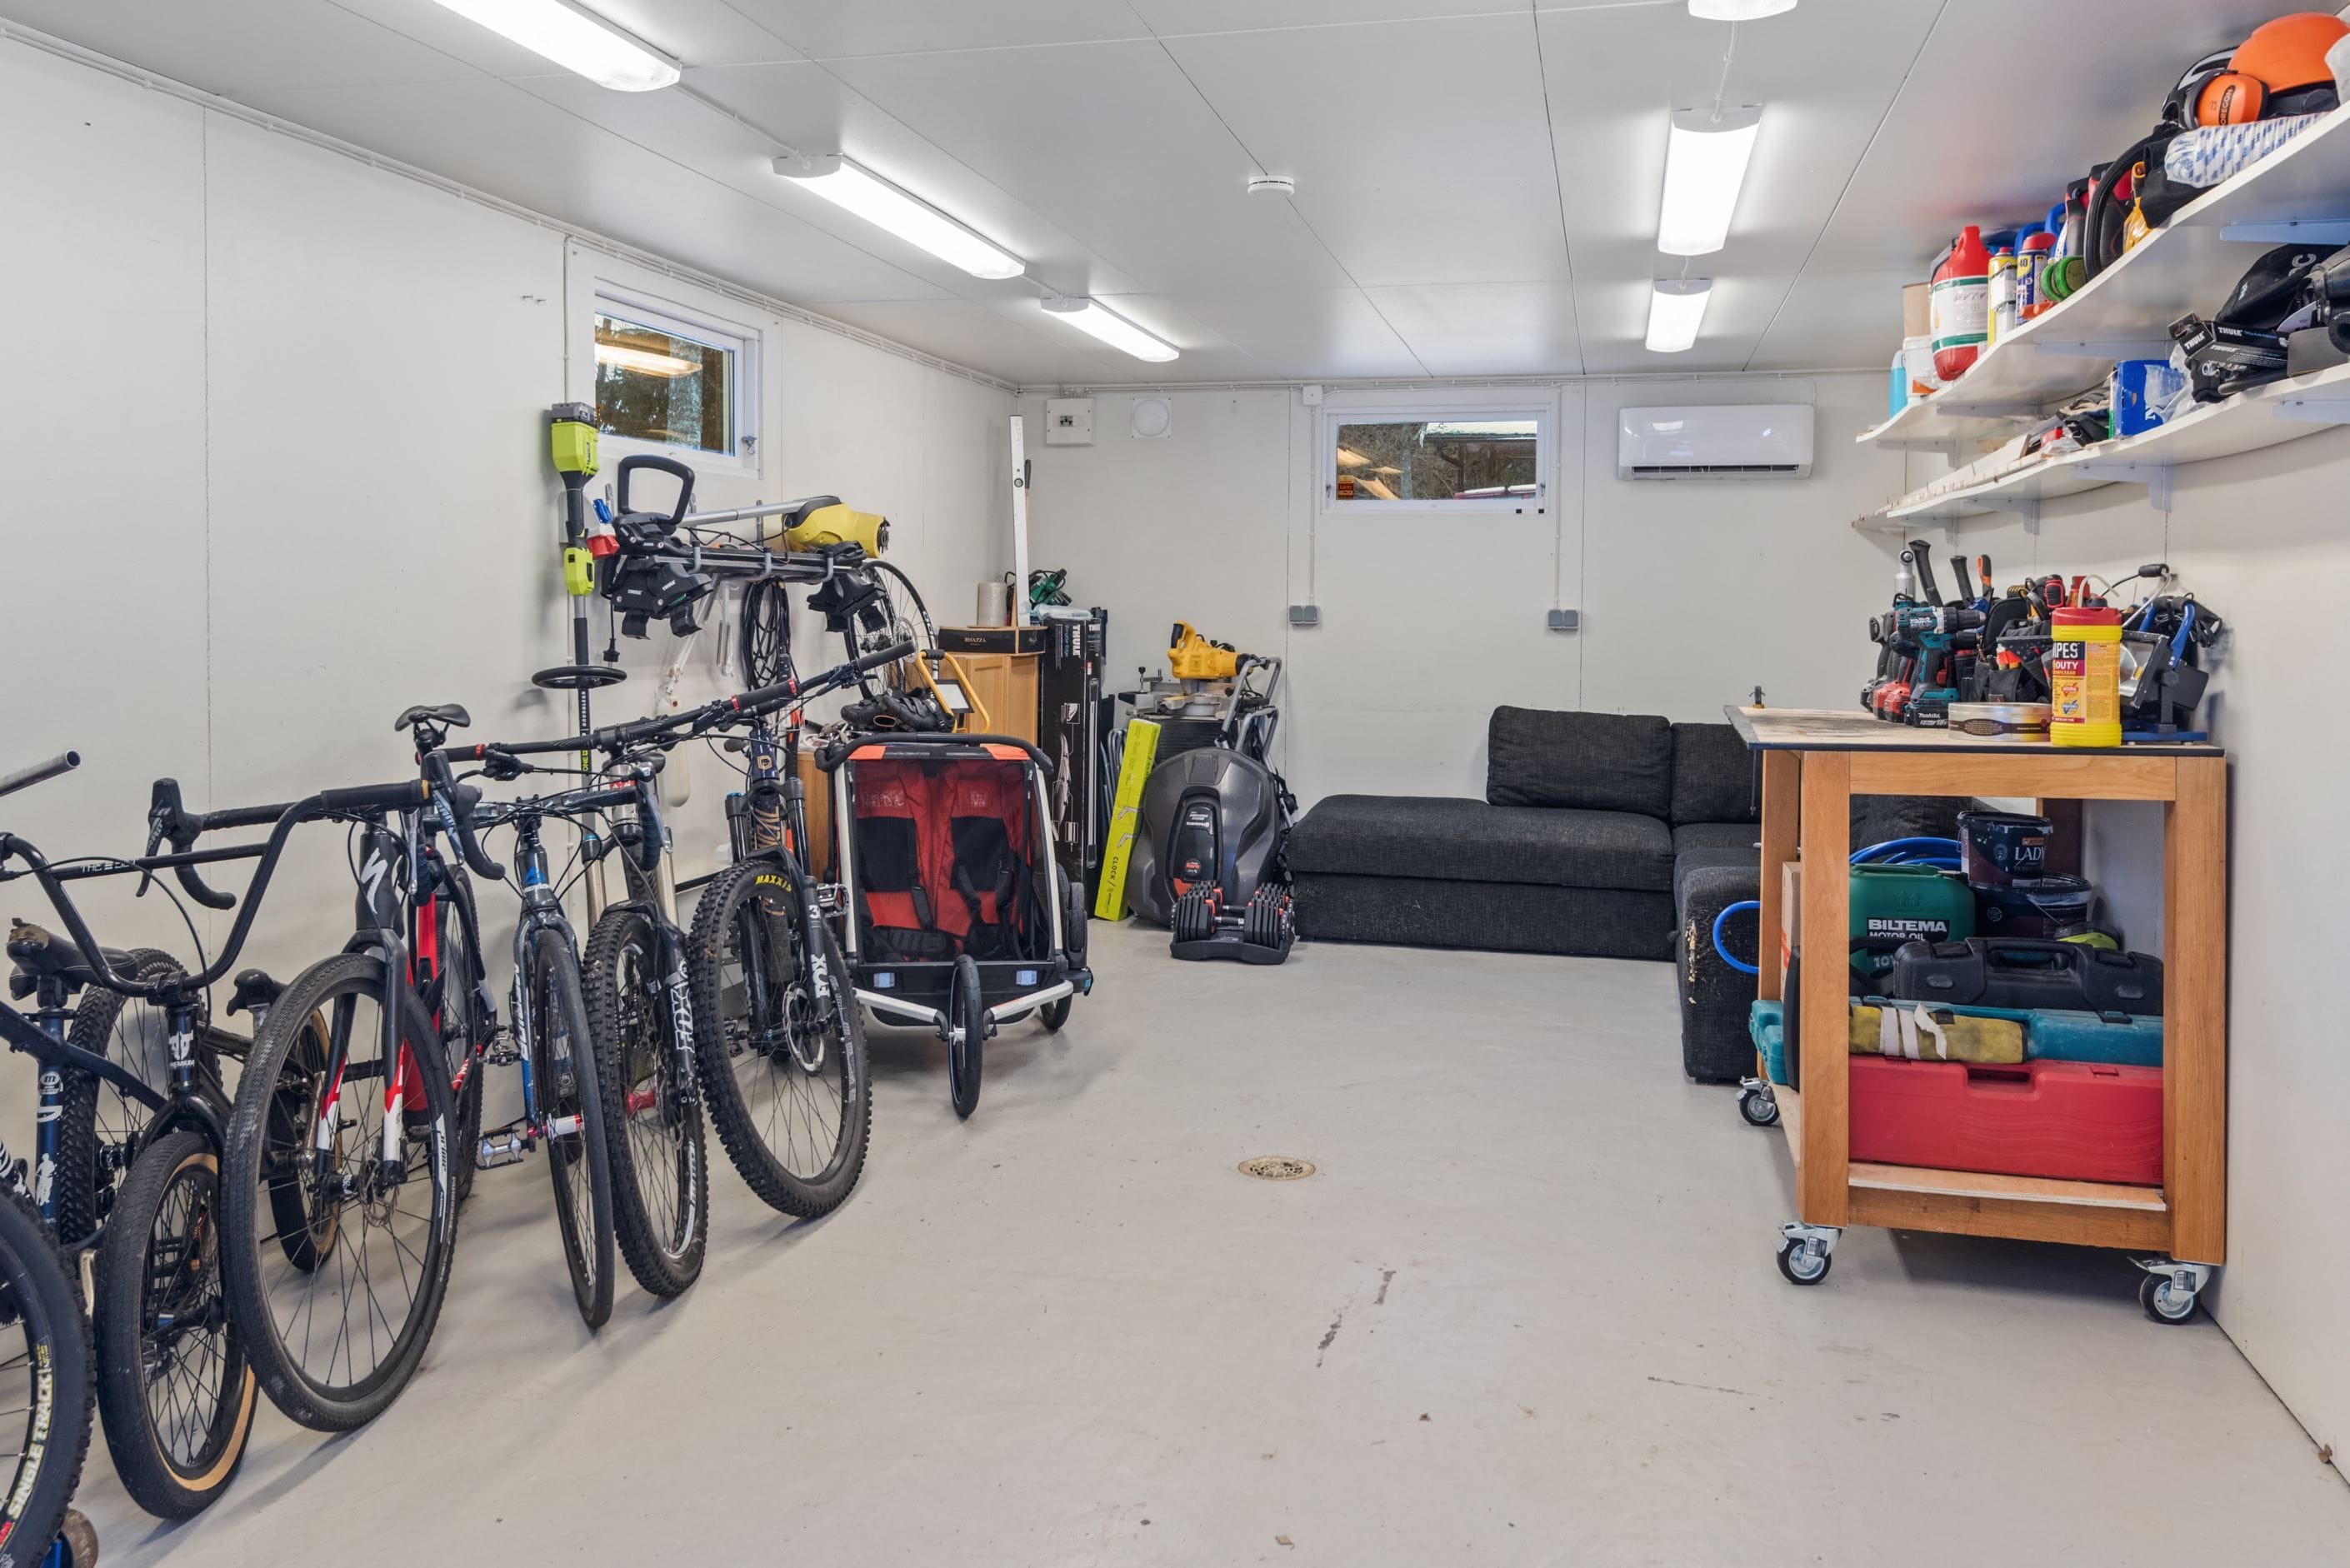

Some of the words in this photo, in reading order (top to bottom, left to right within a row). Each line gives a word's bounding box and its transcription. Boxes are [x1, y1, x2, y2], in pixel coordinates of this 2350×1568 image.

[2220, 88, 2233, 125] OREGON
[2218, 327, 2242, 337] THULE
[2184, 331, 2205, 350] THULE
[2209, 344, 2240, 353] THULE
[1072, 624, 1081, 657] THULE
[2053, 642, 2079, 658] IPES
[2056, 661, 2078, 670] DUTY
[2014, 846, 2046, 861] LADY
[1110, 856, 1119, 881] CLOCK
[755, 875, 792, 892] MAXXIS
[1868, 919, 1948, 931] BILTEMA
[1908, 932, 1926, 941] OIL
[810, 953, 831, 998] FOX
[670, 986, 695, 1054] FOX
[169, 1058, 195, 1067] PREMIUM
[7, 1442, 45, 1521] SINGLE
[32, 1371, 53, 1442] TRACK
